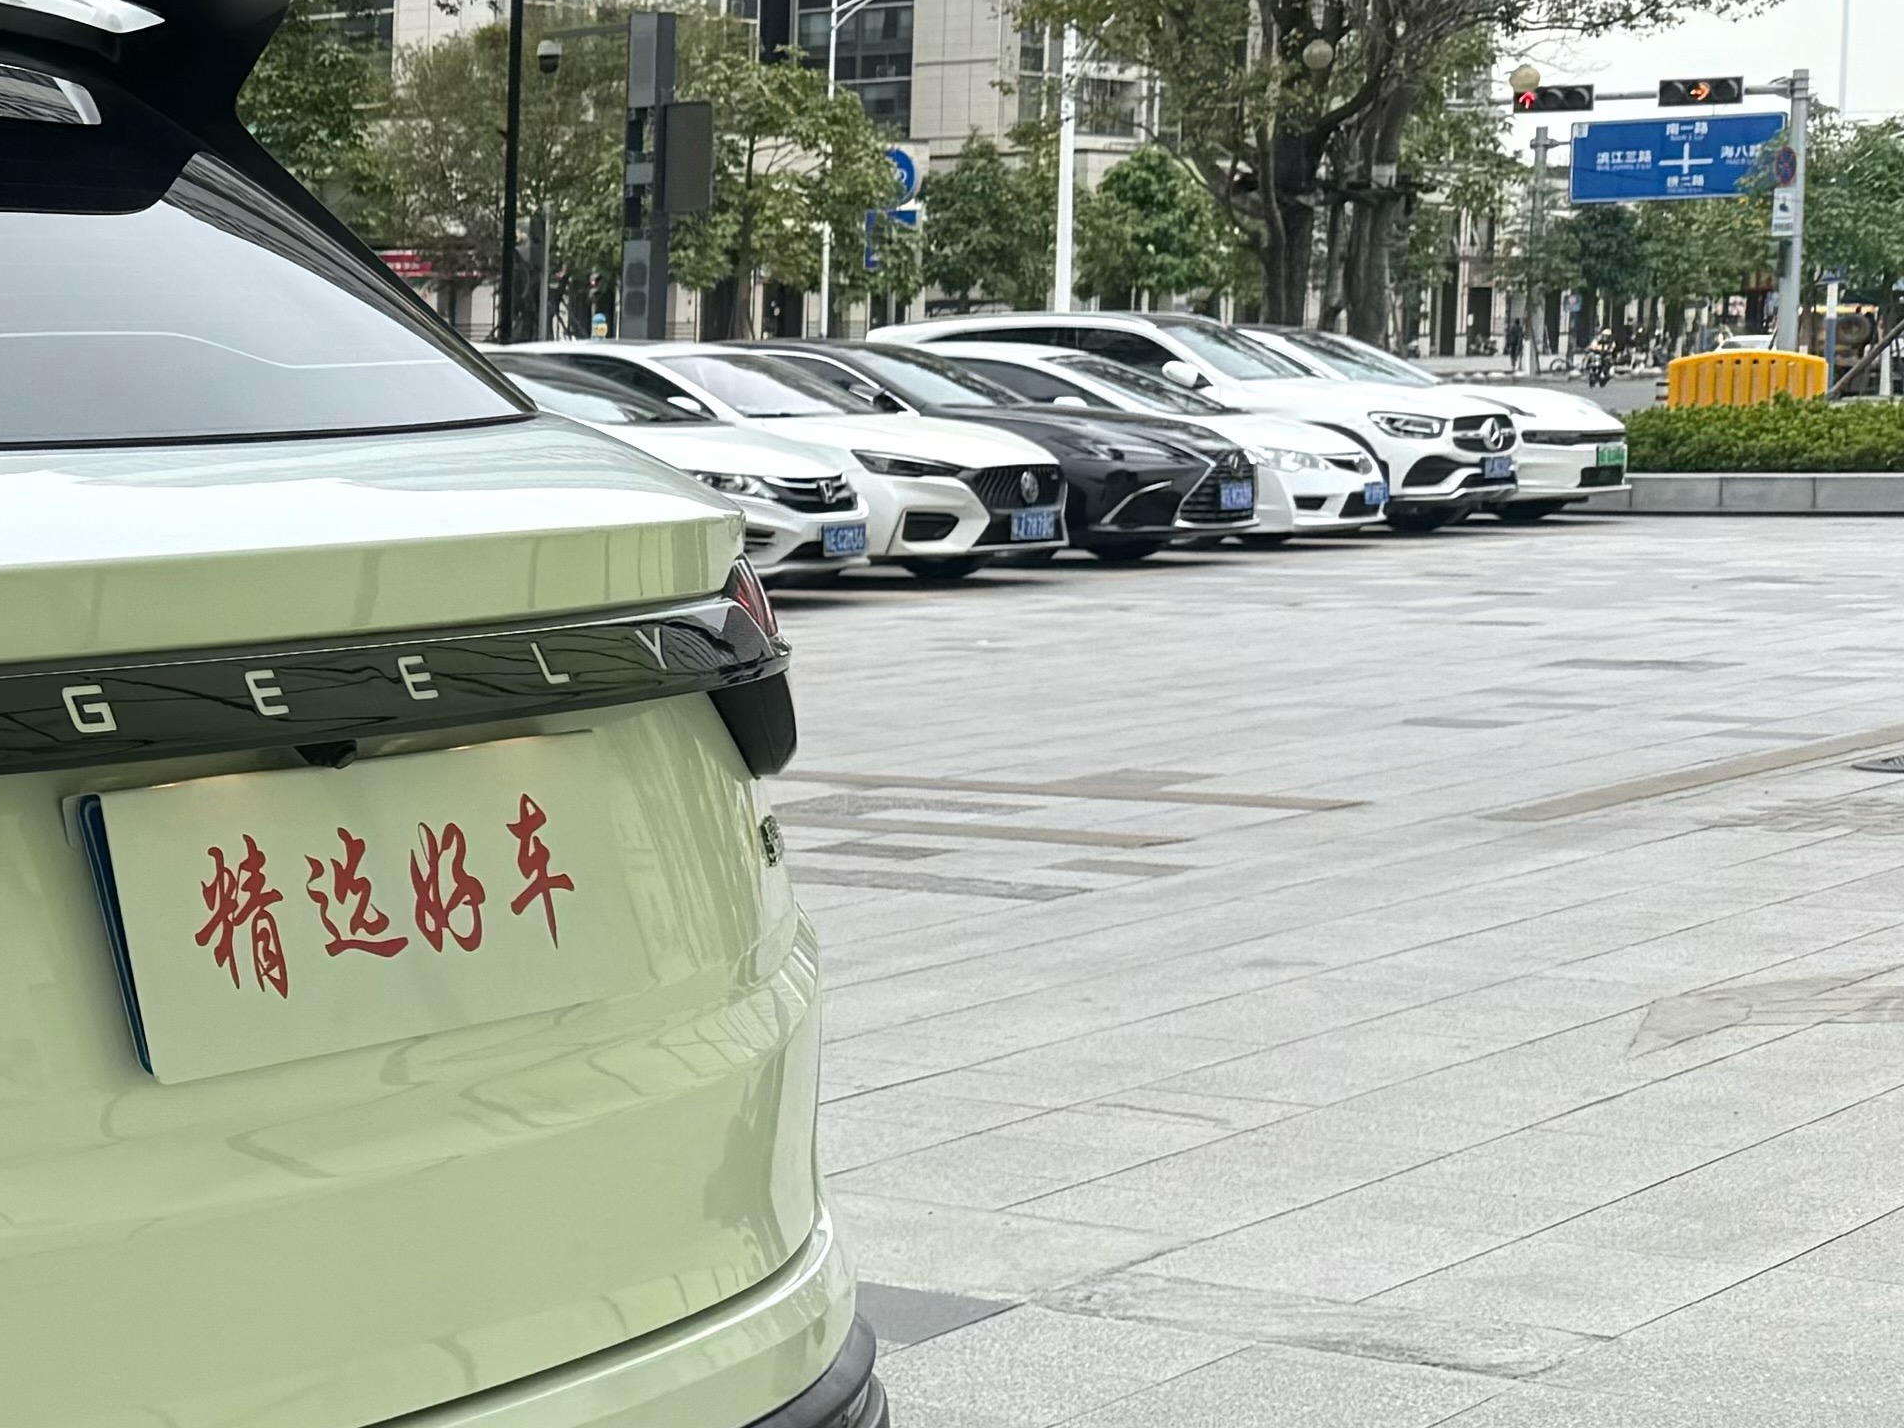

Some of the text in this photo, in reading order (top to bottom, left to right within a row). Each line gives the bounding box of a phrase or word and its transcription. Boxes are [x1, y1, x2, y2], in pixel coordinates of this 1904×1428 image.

[61, 626, 674, 735] GEELY
[194, 792, 576, 1000] 精选好车
